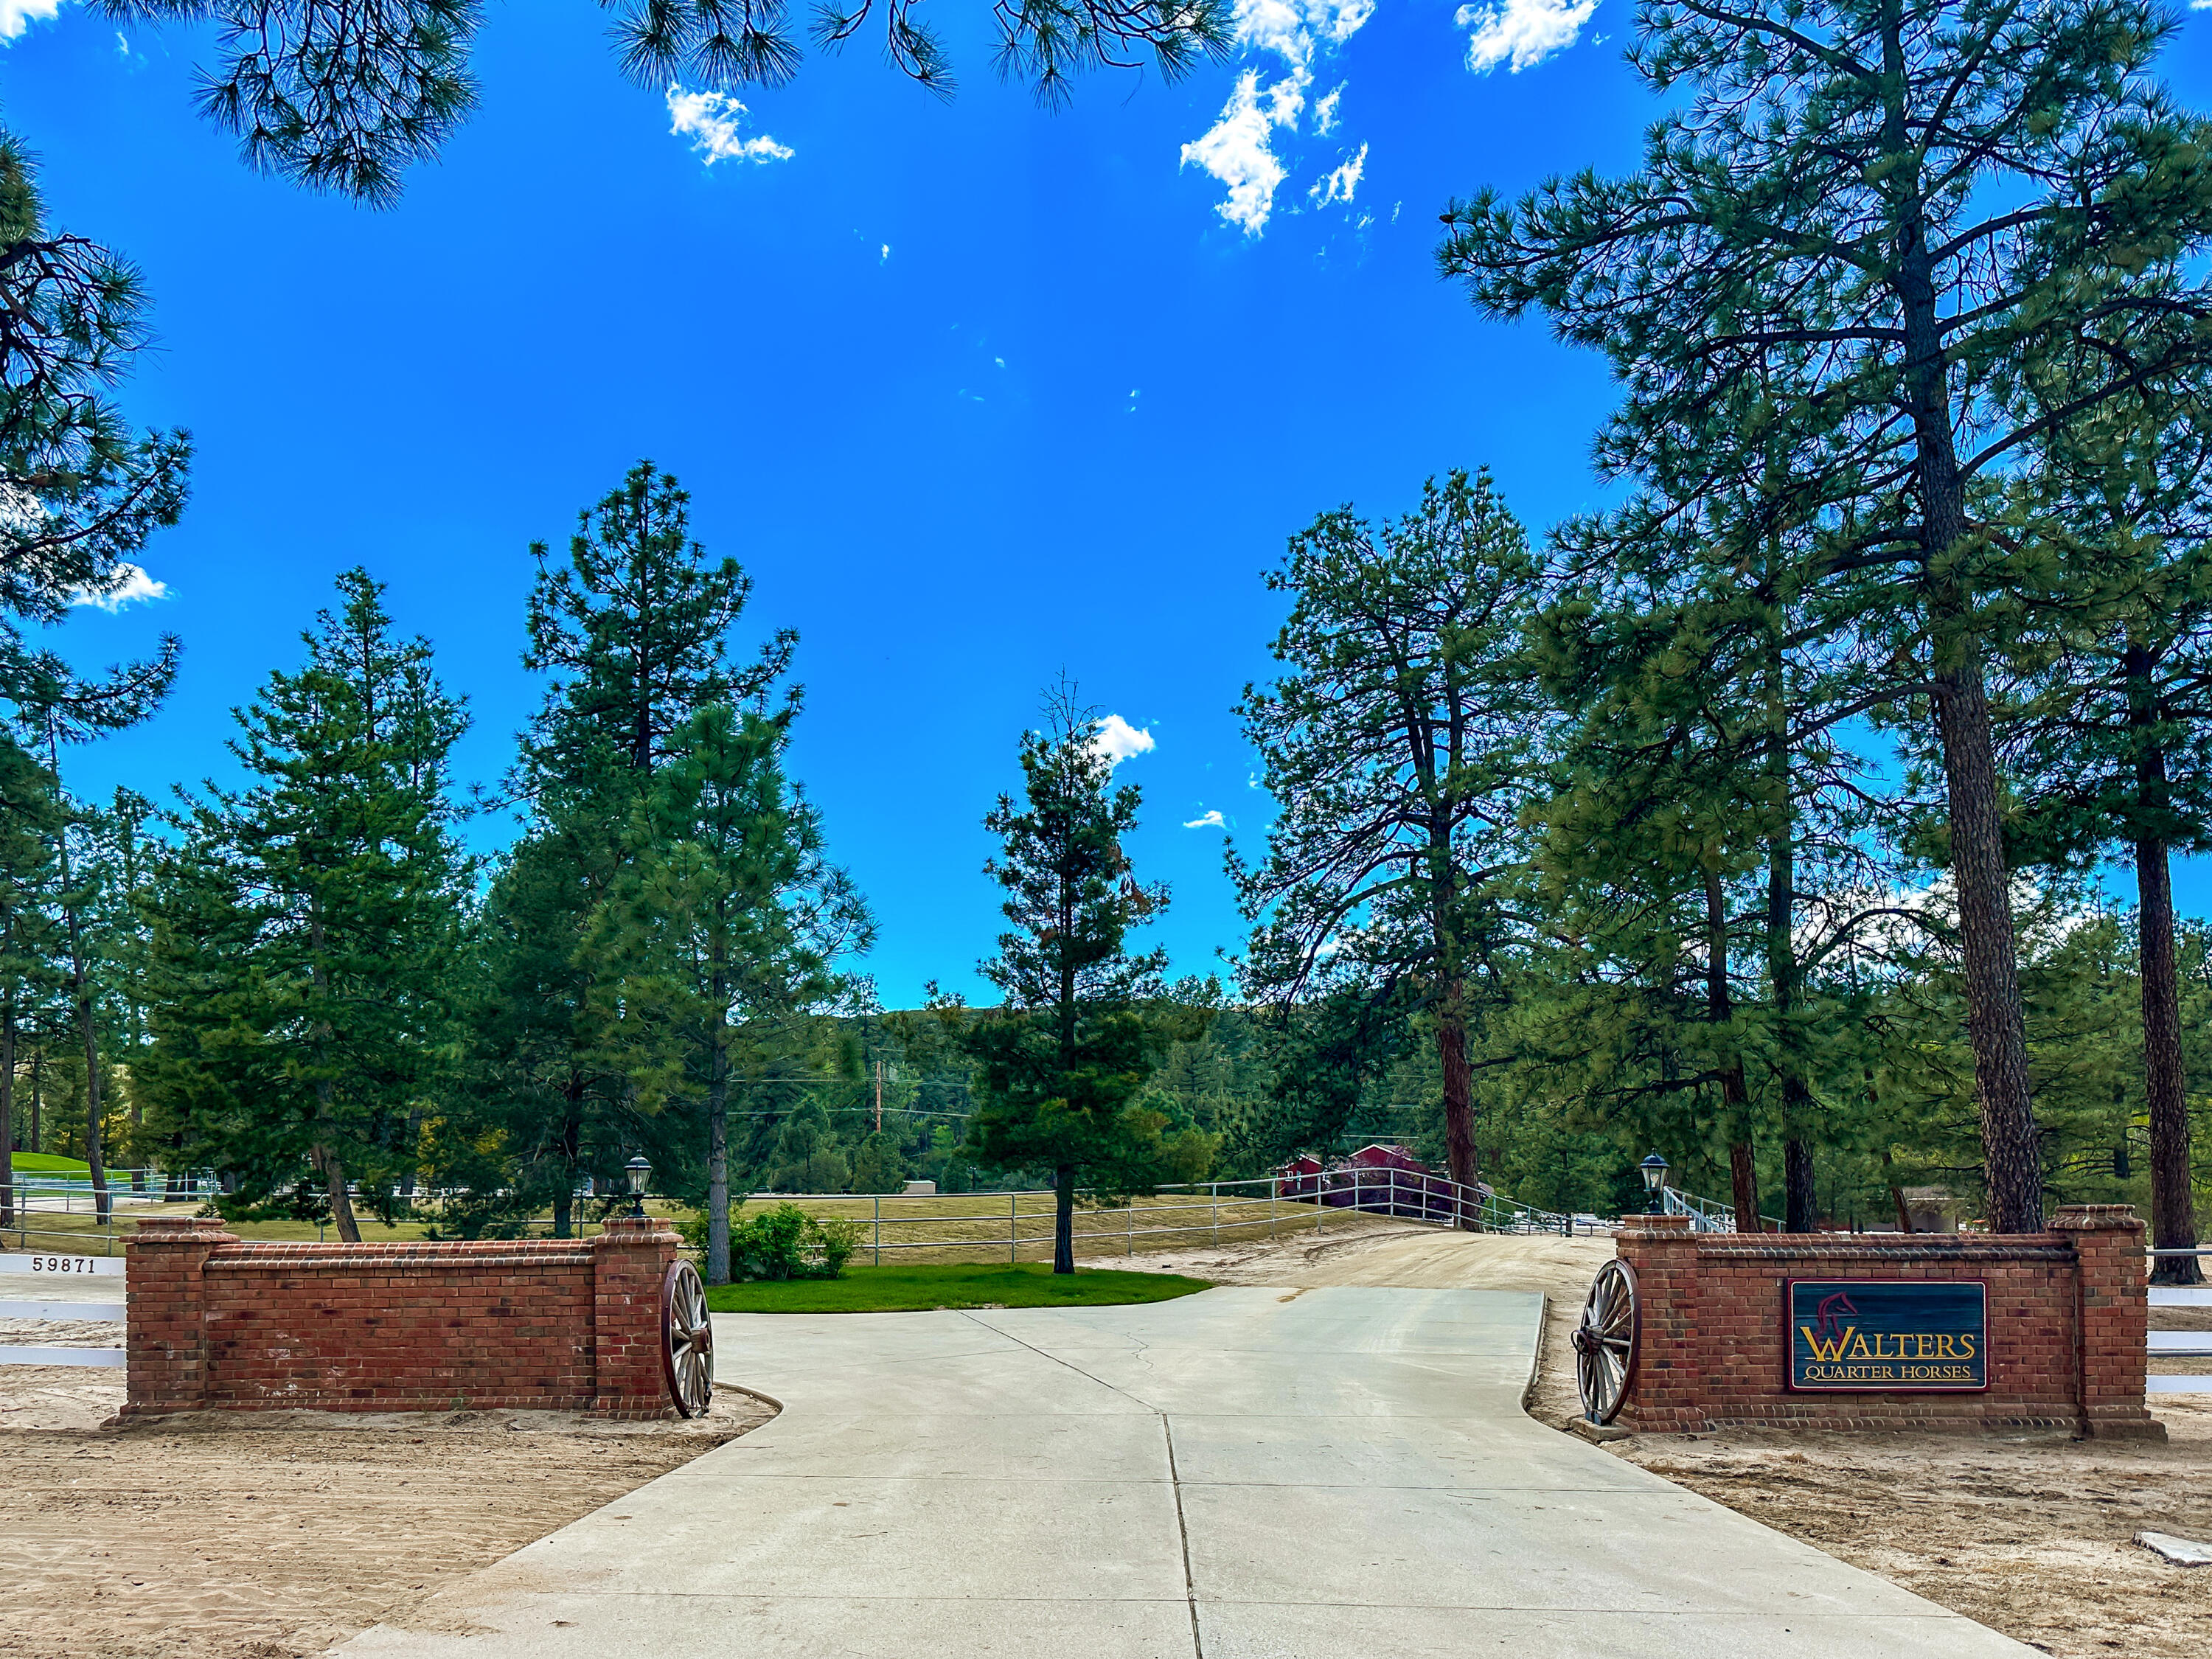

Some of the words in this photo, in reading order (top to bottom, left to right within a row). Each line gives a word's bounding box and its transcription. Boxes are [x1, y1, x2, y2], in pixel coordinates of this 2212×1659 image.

[32, 1257, 94, 1273] 59871
[1800, 1326, 1975, 1362] WALTERS
[1804, 1366, 1893, 1381] QUARTER
[1901, 1366, 1971, 1379] HORSES
